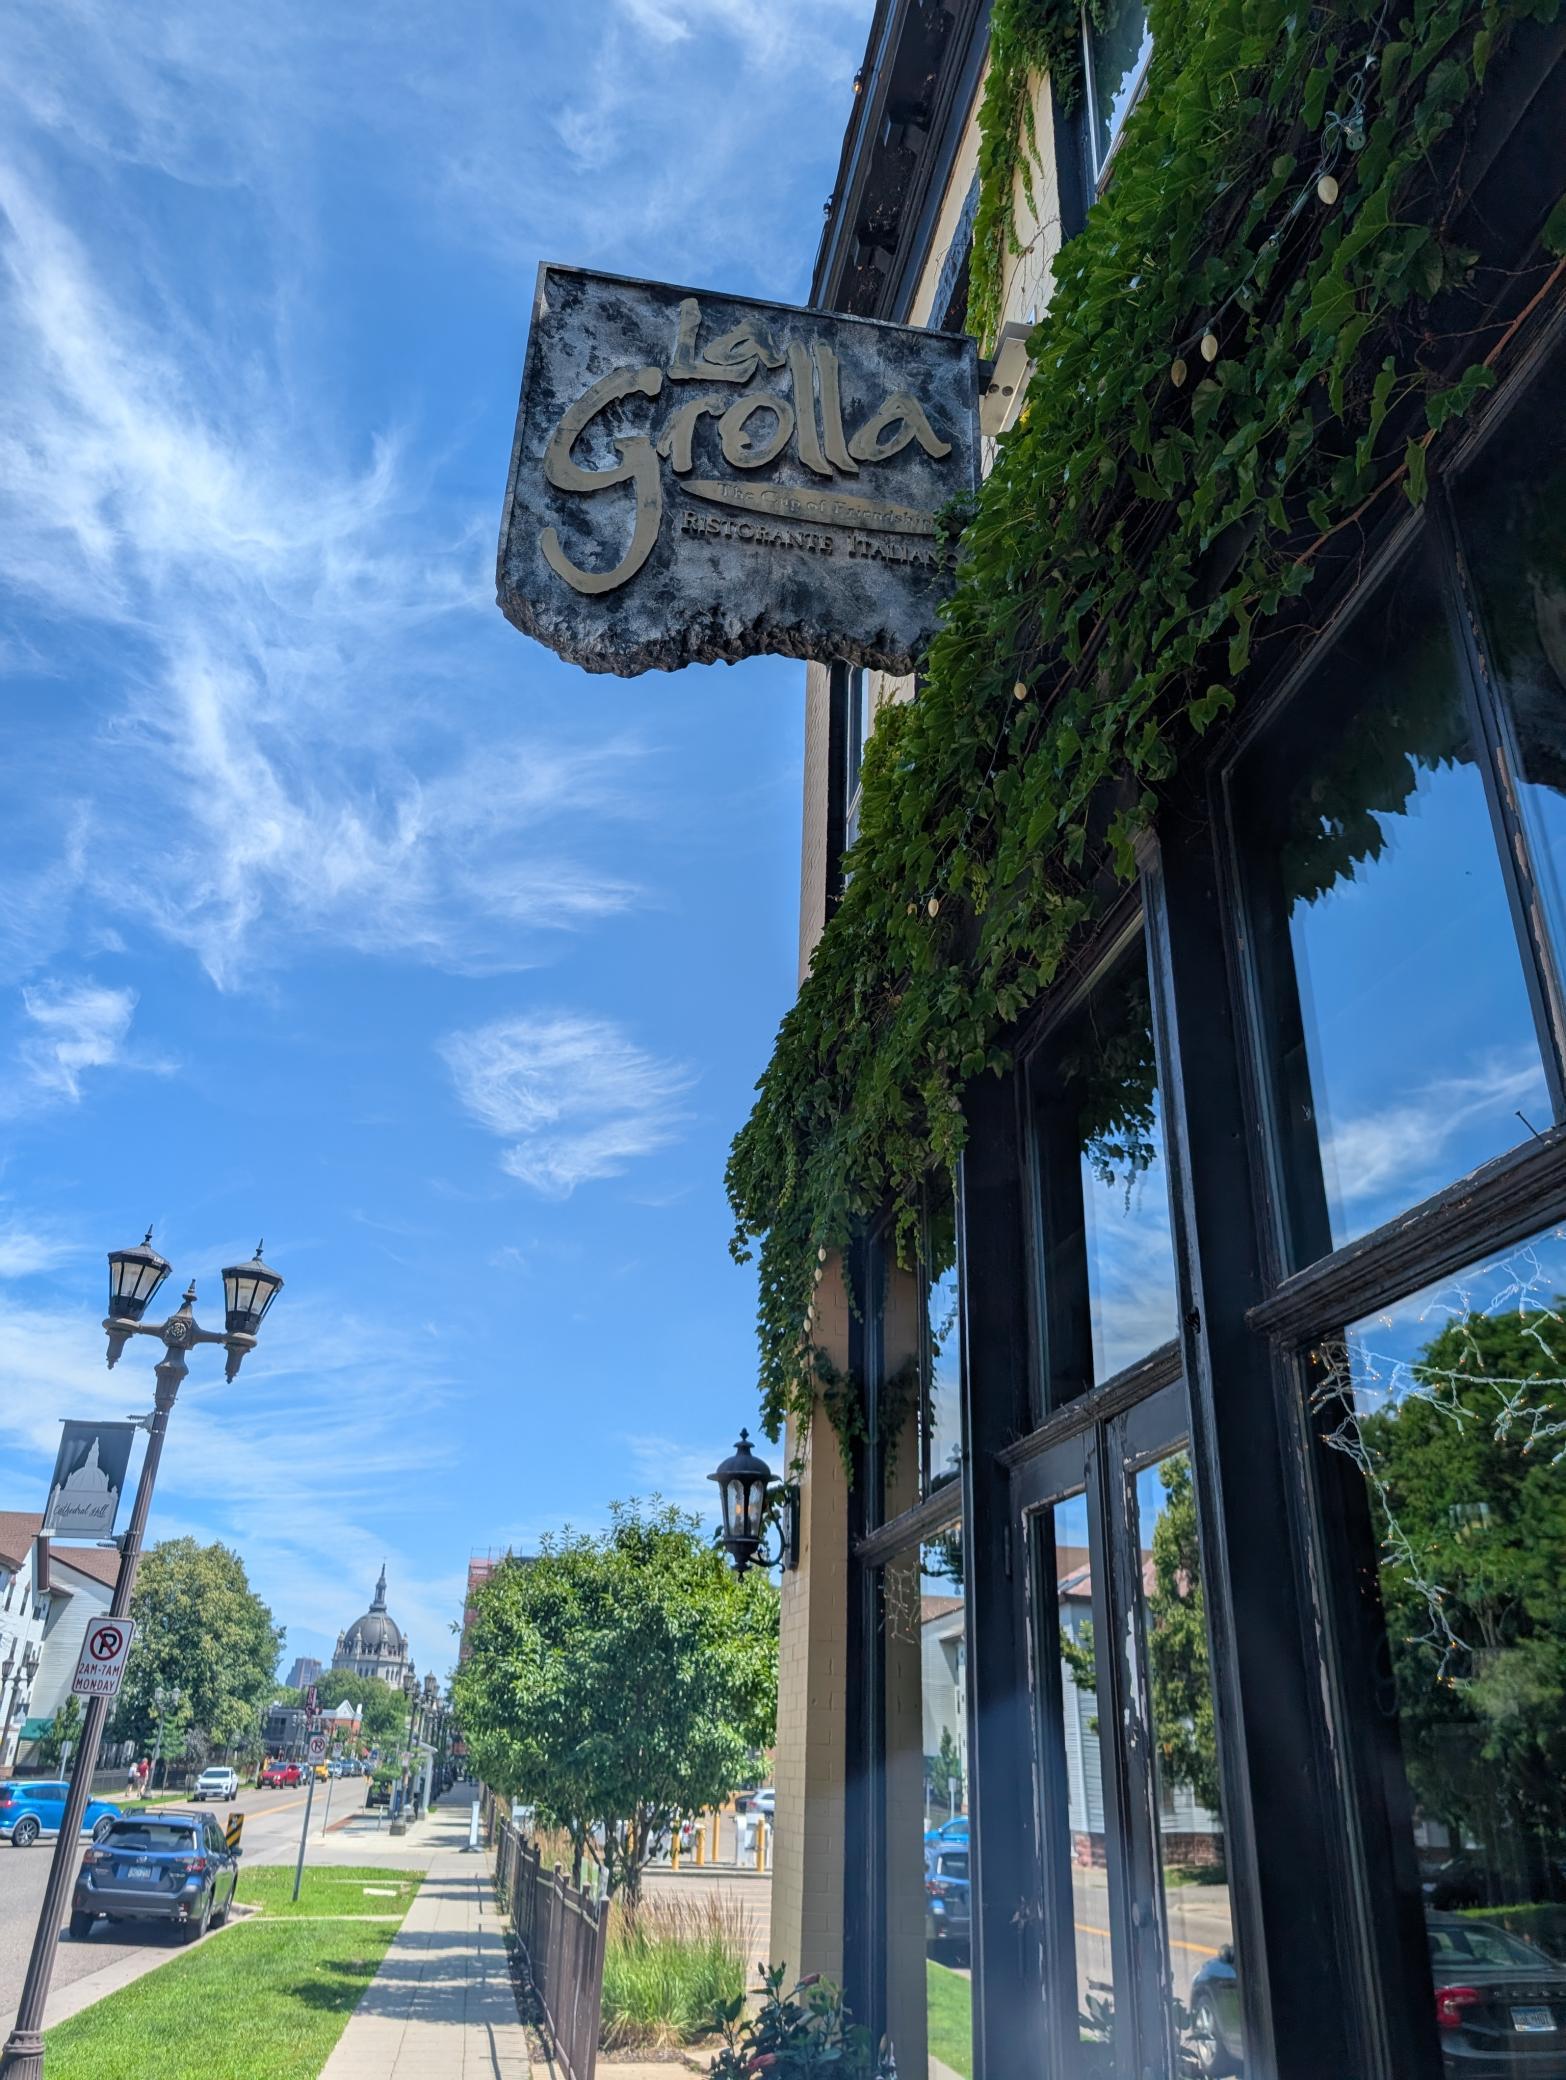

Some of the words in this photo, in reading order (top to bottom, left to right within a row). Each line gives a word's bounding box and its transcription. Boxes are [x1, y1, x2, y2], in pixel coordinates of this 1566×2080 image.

[667, 297, 786, 383] La
[540, 340, 952, 593] Grolla
[717, 482, 754, 500] The
[760, 489, 801, 512] Cup
[807, 500, 825, 513] of
[831, 501, 935, 531] Friendship
[54, 1502, 91, 1517] Cathedral
[89, 1503, 110, 1518] Hill
[75, 1678, 115, 1692] MONDAY
